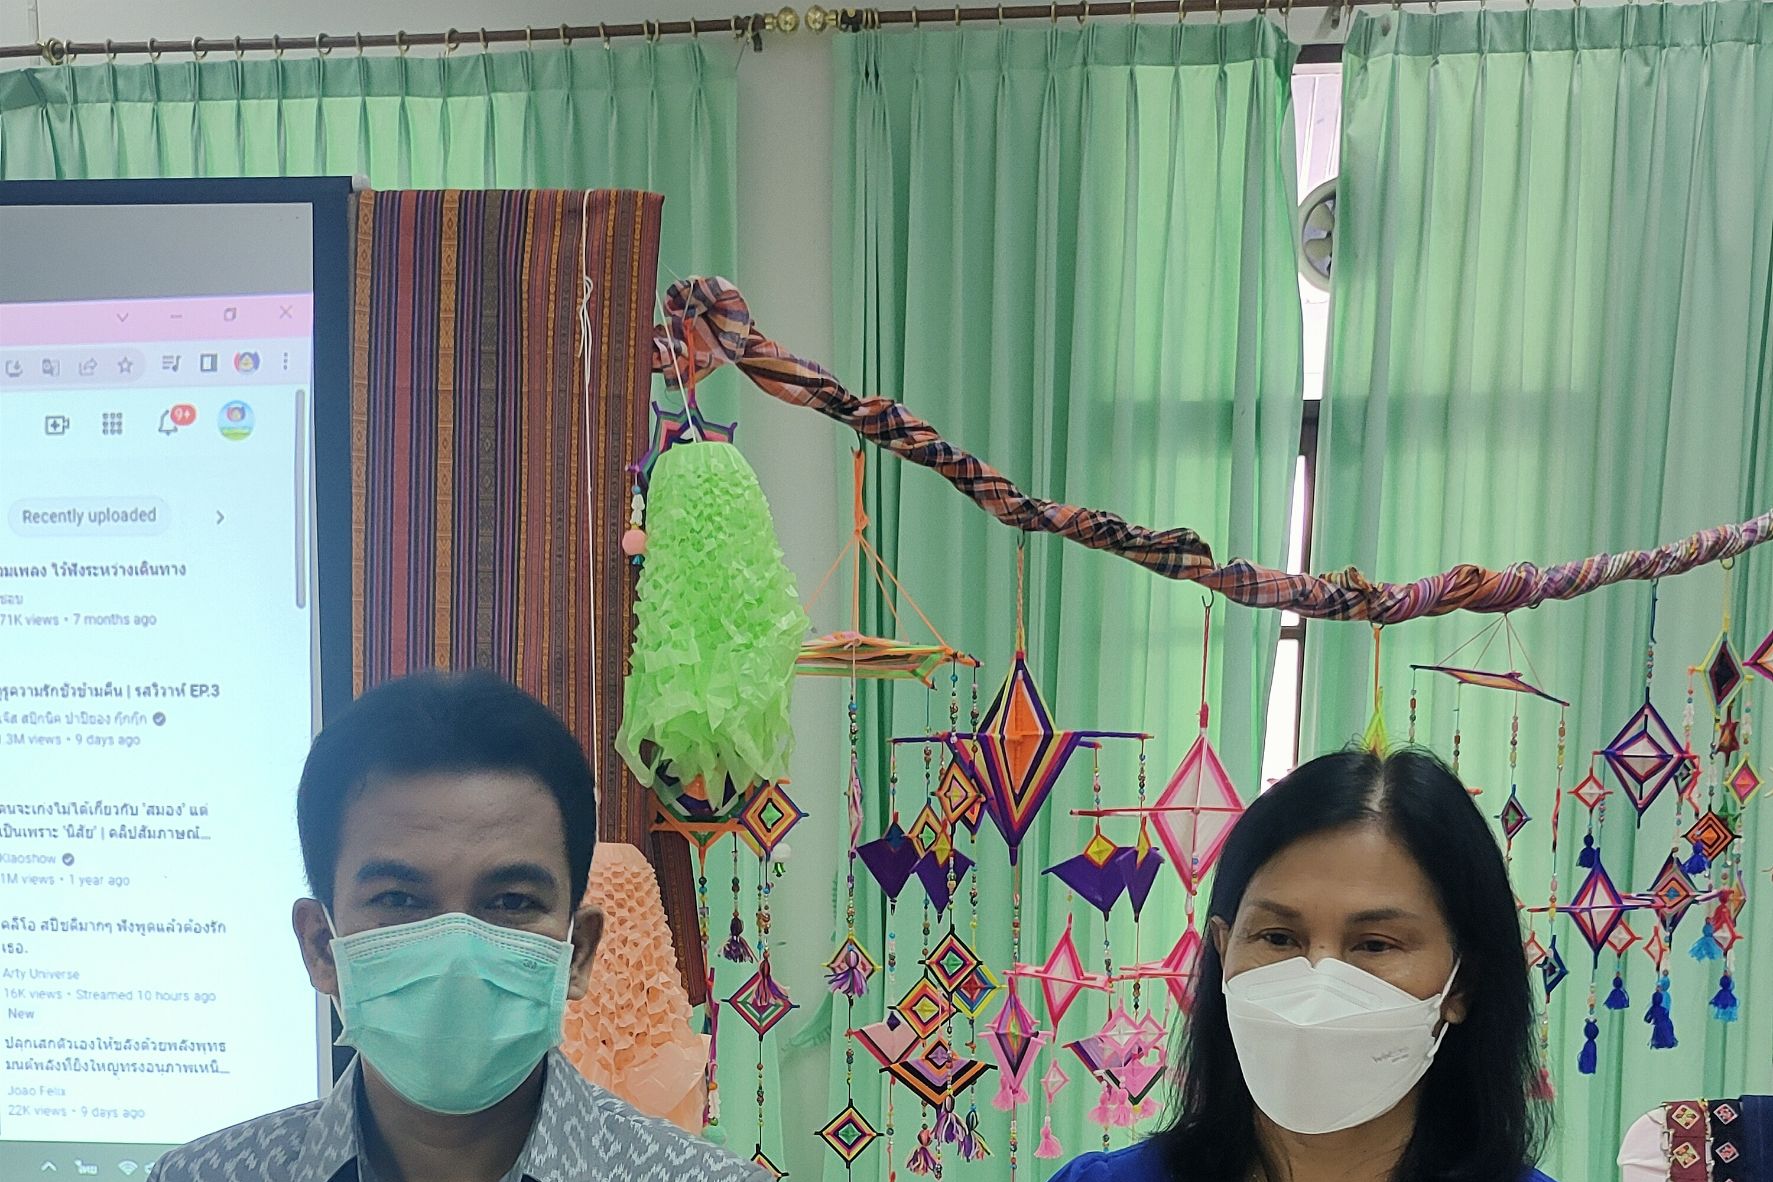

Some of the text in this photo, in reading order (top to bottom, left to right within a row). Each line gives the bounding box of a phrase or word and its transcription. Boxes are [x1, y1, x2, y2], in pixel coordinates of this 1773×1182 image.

[22, 507, 157, 526] Recently uploaded
[26, 613, 59, 626] views
[73, 613, 81, 625] 7
[84, 613, 130, 626] months
[134, 616, 157, 628] ago
[190, 684, 220, 698] EP.3
[28, 735, 61, 746] views
[75, 733, 83, 745] 9
[86, 733, 115, 747] days
[118, 735, 141, 748] ago
[21, 874, 55, 885] views
[78, 875, 104, 888] year
[107, 875, 131, 887] ago
[30, 968, 80, 981] Universe
[4, 987, 217, 1004] 16K views Streamed 10 hours ago
[8, 1007, 35, 1020] New
[8, 1104, 146, 1120] 22K views 9 days ago
